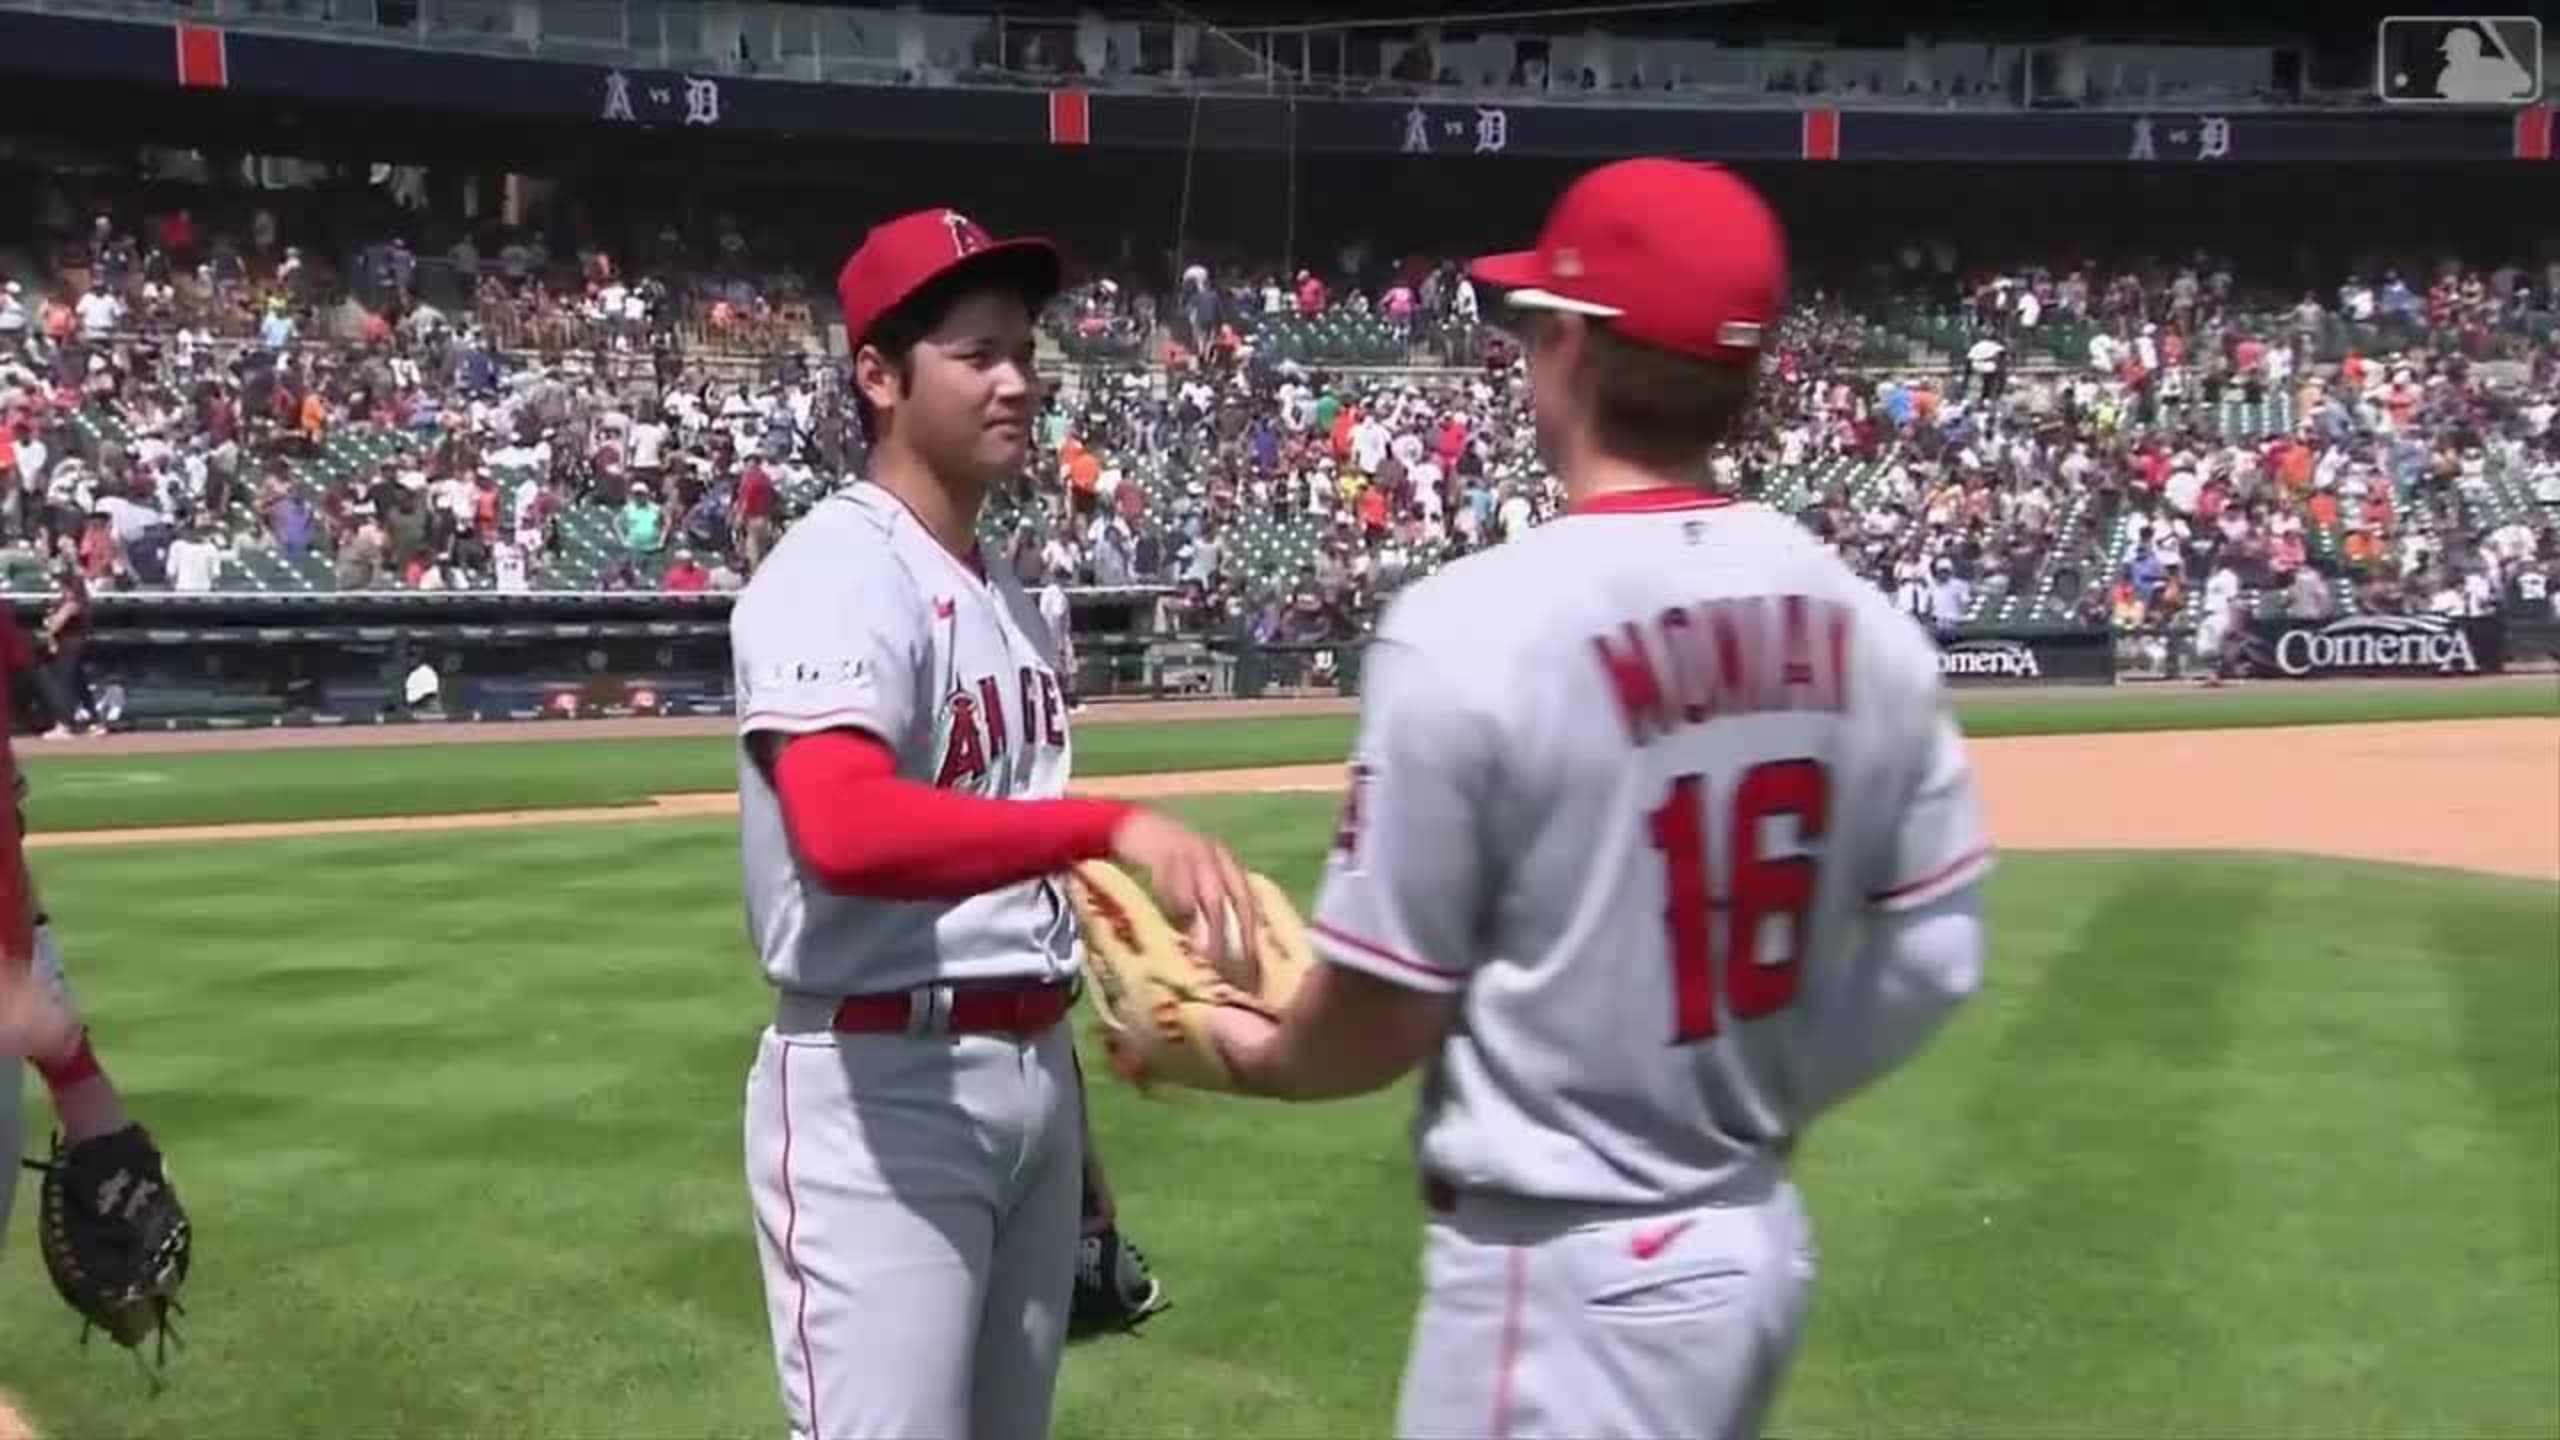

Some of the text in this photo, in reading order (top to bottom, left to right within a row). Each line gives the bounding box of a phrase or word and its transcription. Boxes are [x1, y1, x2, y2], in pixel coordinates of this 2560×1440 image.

[603, 70, 636, 121] A
[685, 76, 719, 125] D
[1402, 105, 1430, 153] A
[1475, 109, 1508, 153] D
[2197, 117, 2231, 160] D
[1645, 757, 1832, 1047] 16
